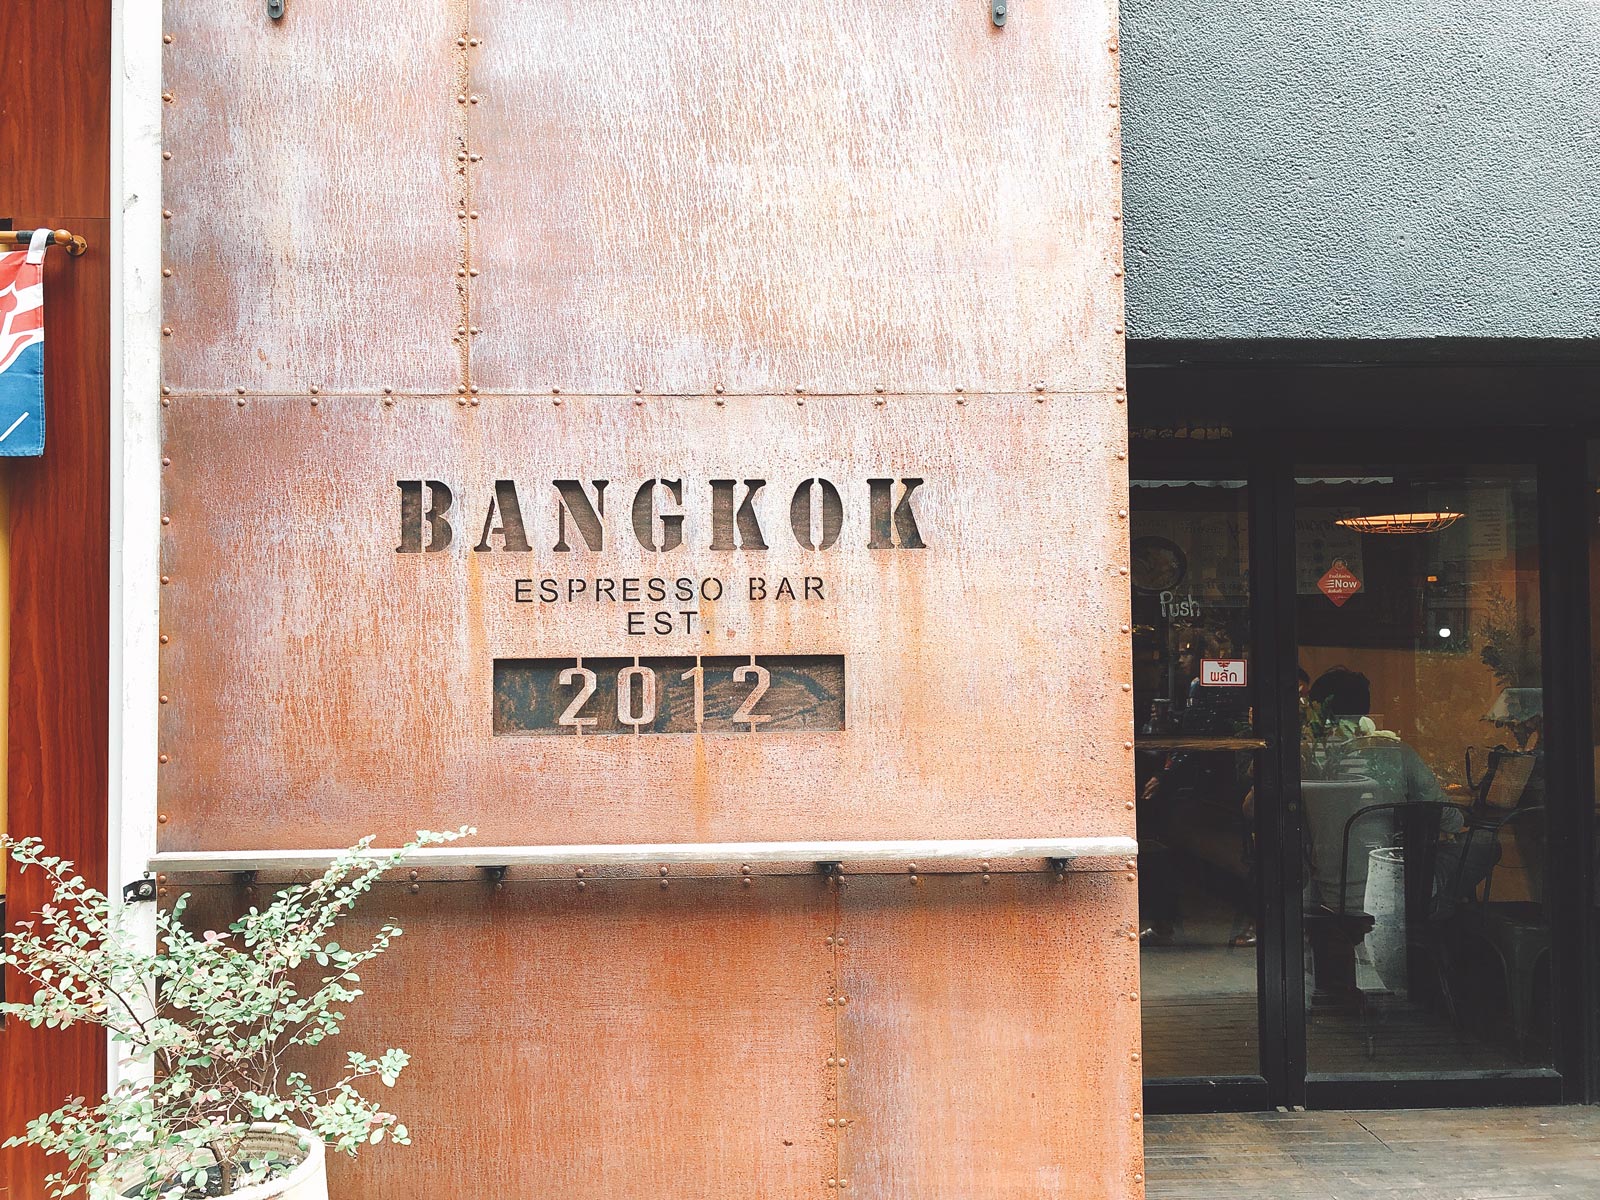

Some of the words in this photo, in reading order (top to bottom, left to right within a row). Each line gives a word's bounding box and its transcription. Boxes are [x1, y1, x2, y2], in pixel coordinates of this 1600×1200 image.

[396, 478, 926, 553] BANGKOK
[515, 577, 723, 602] ESPRESSO
[749, 576, 825, 600] BAR
[1335, 579, 1357, 588] Now
[1160, 591, 1200, 617] Push
[627, 611, 711, 635] EST.
[1210, 669, 1237, 682] ผลัก
[559, 665, 772, 726] 2012
